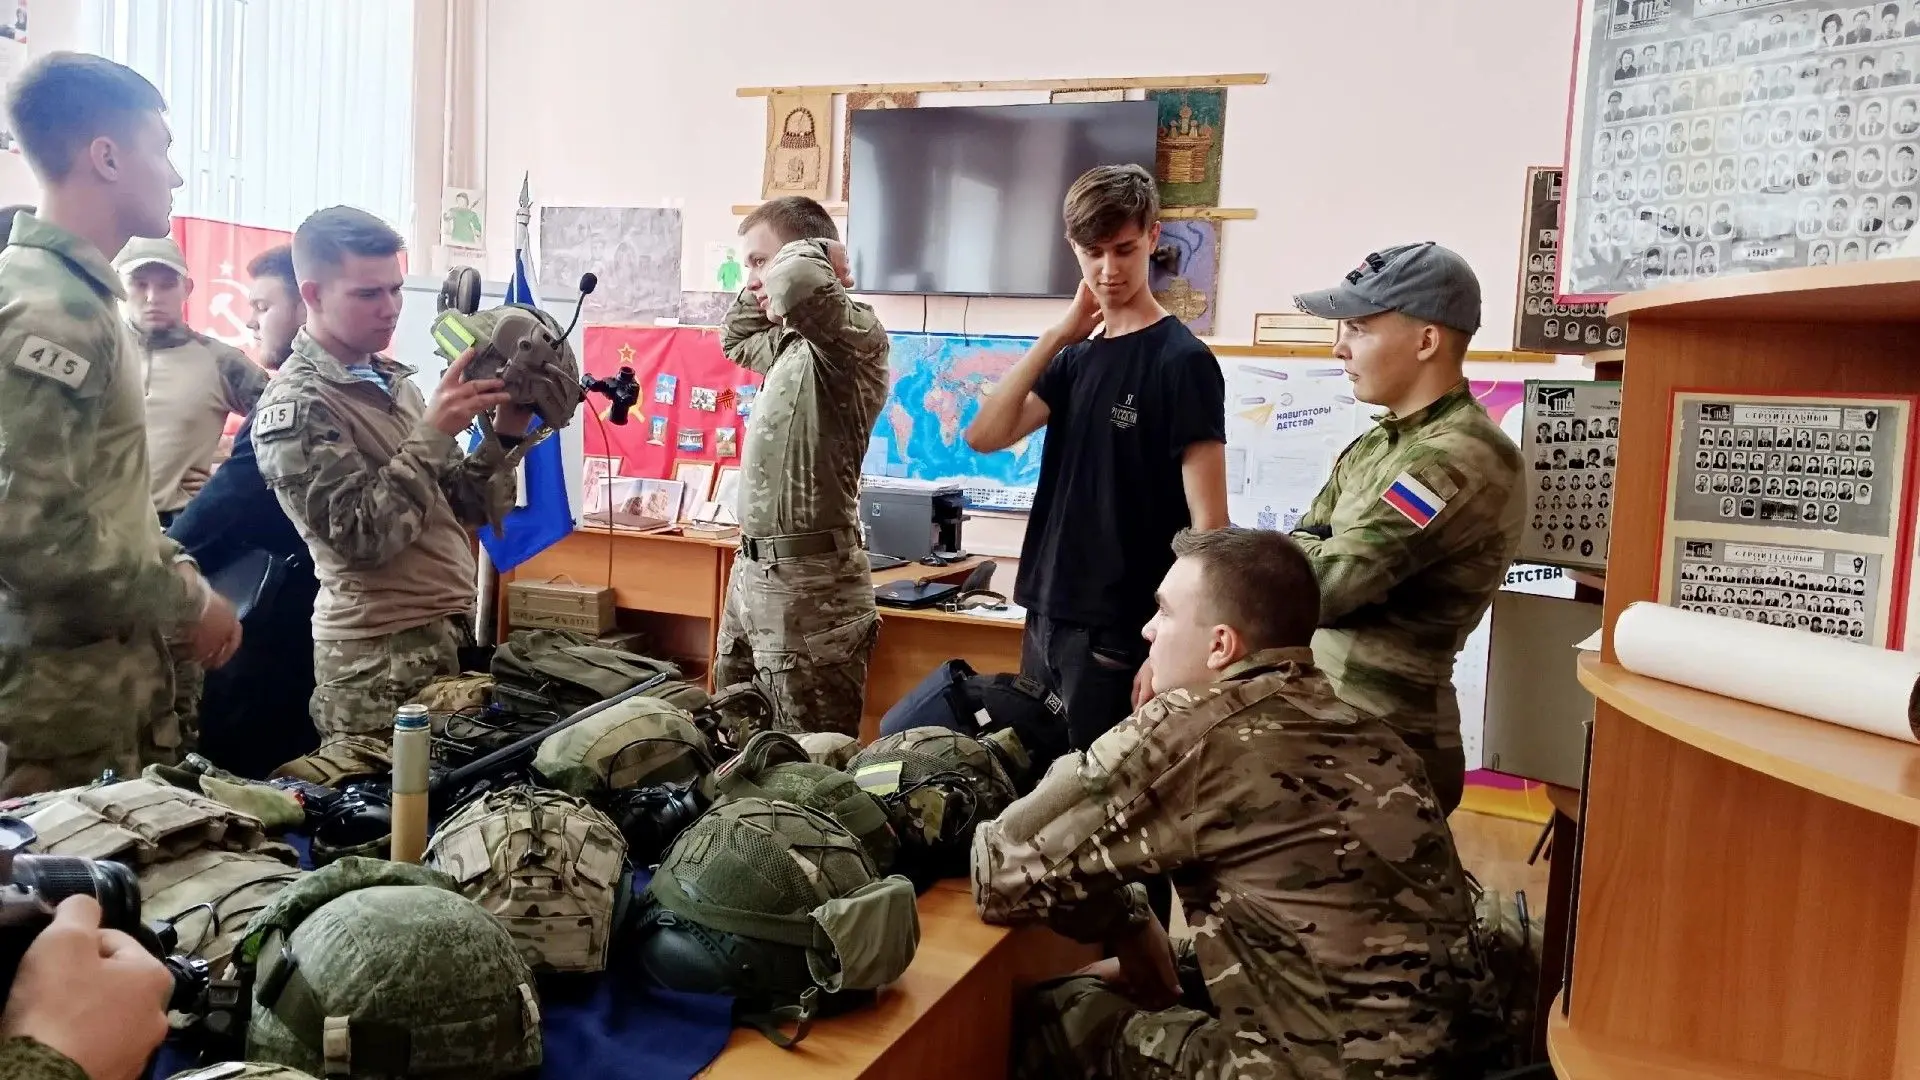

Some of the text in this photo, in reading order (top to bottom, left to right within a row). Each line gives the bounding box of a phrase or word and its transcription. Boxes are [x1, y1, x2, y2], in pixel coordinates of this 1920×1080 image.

[28, 347, 78, 375] 415
[1125, 393, 1135, 405] Я
[261, 408, 287, 424] 415
[1276, 406, 1332, 421] НАВИГАТОРЫ
[1276, 418, 1314, 431] ДЕТСТВА
[1503, 567, 1563, 586] ЕТСТВА
